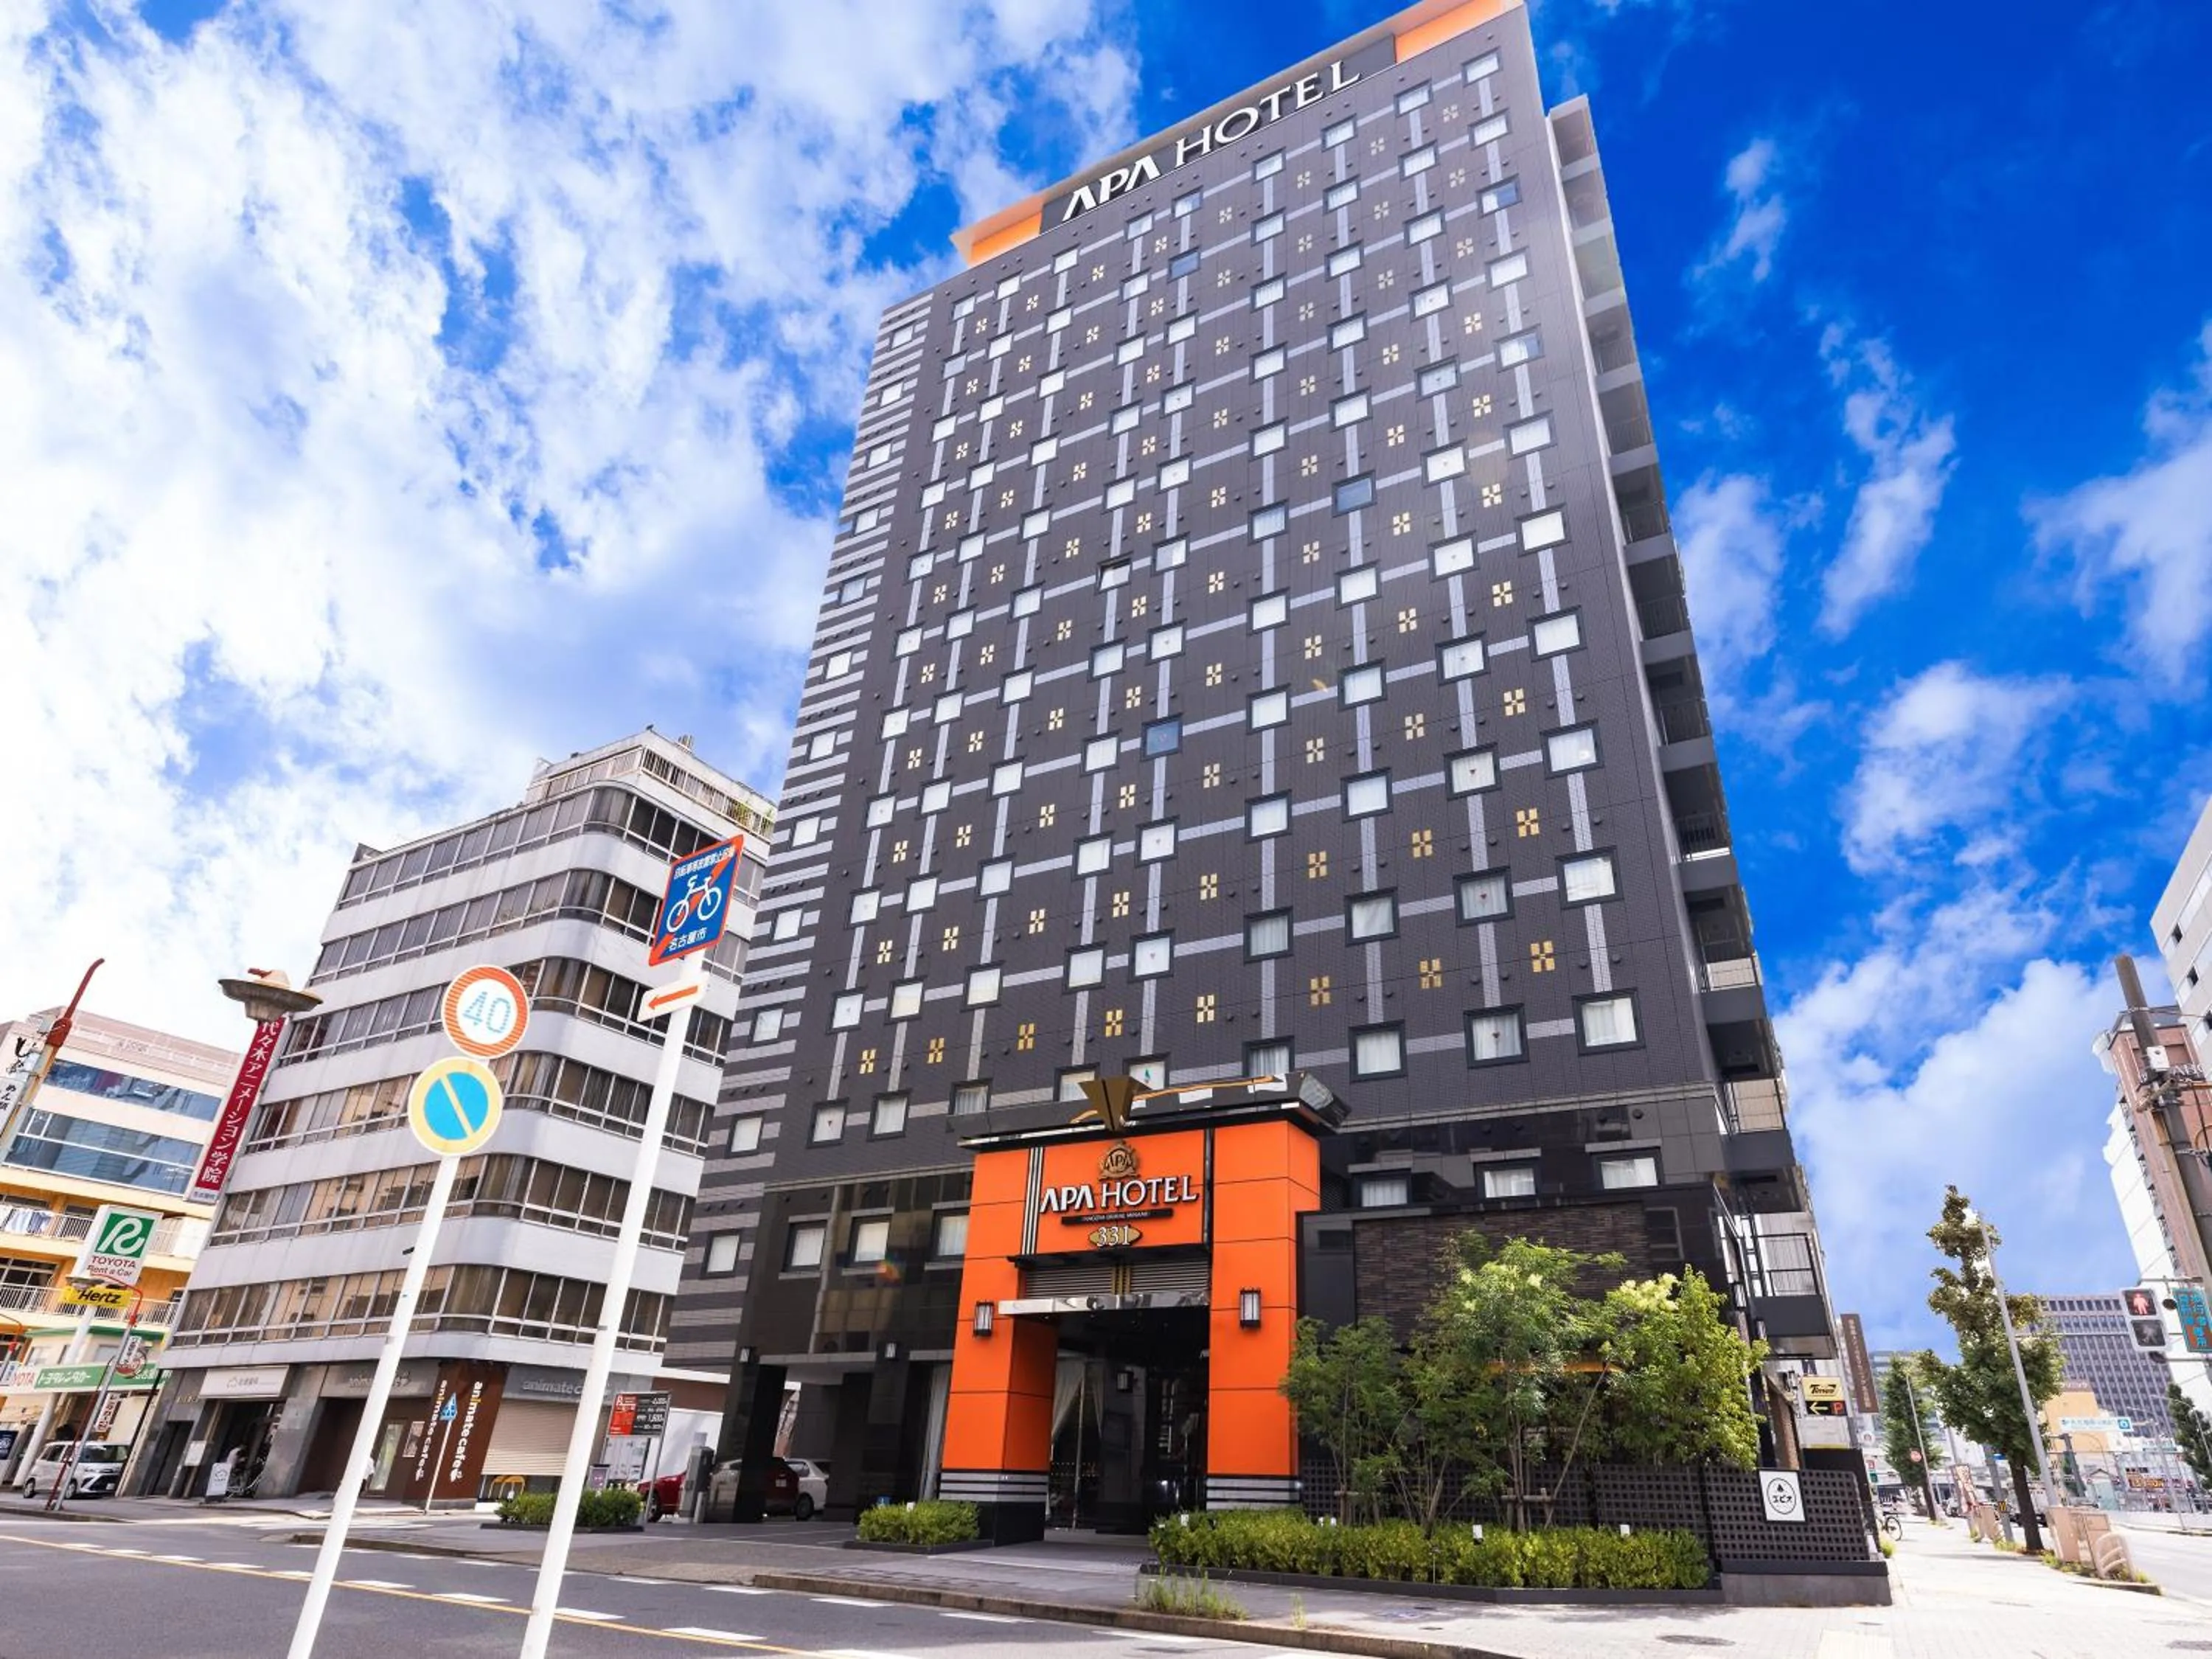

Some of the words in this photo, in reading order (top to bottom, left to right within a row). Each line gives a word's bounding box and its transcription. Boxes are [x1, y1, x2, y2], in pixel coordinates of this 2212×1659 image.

[1062, 154, 1161, 221] APA
[1175, 60, 1360, 168] HOTEL
[668, 927, 708, 952] 名古屋市
[462, 991, 511, 1034] 40
[201, 1020, 280, 1184] 代々木アニメーション学院
[1039, 1185, 1094, 1213] APA
[1101, 1176, 1198, 1207] HOTEL
[1097, 1225, 1130, 1246] 331
[87, 1265, 108, 1274] Rent
[92, 1256, 136, 1268] TOYOTA
[78, 1290, 122, 1304] Hertz
